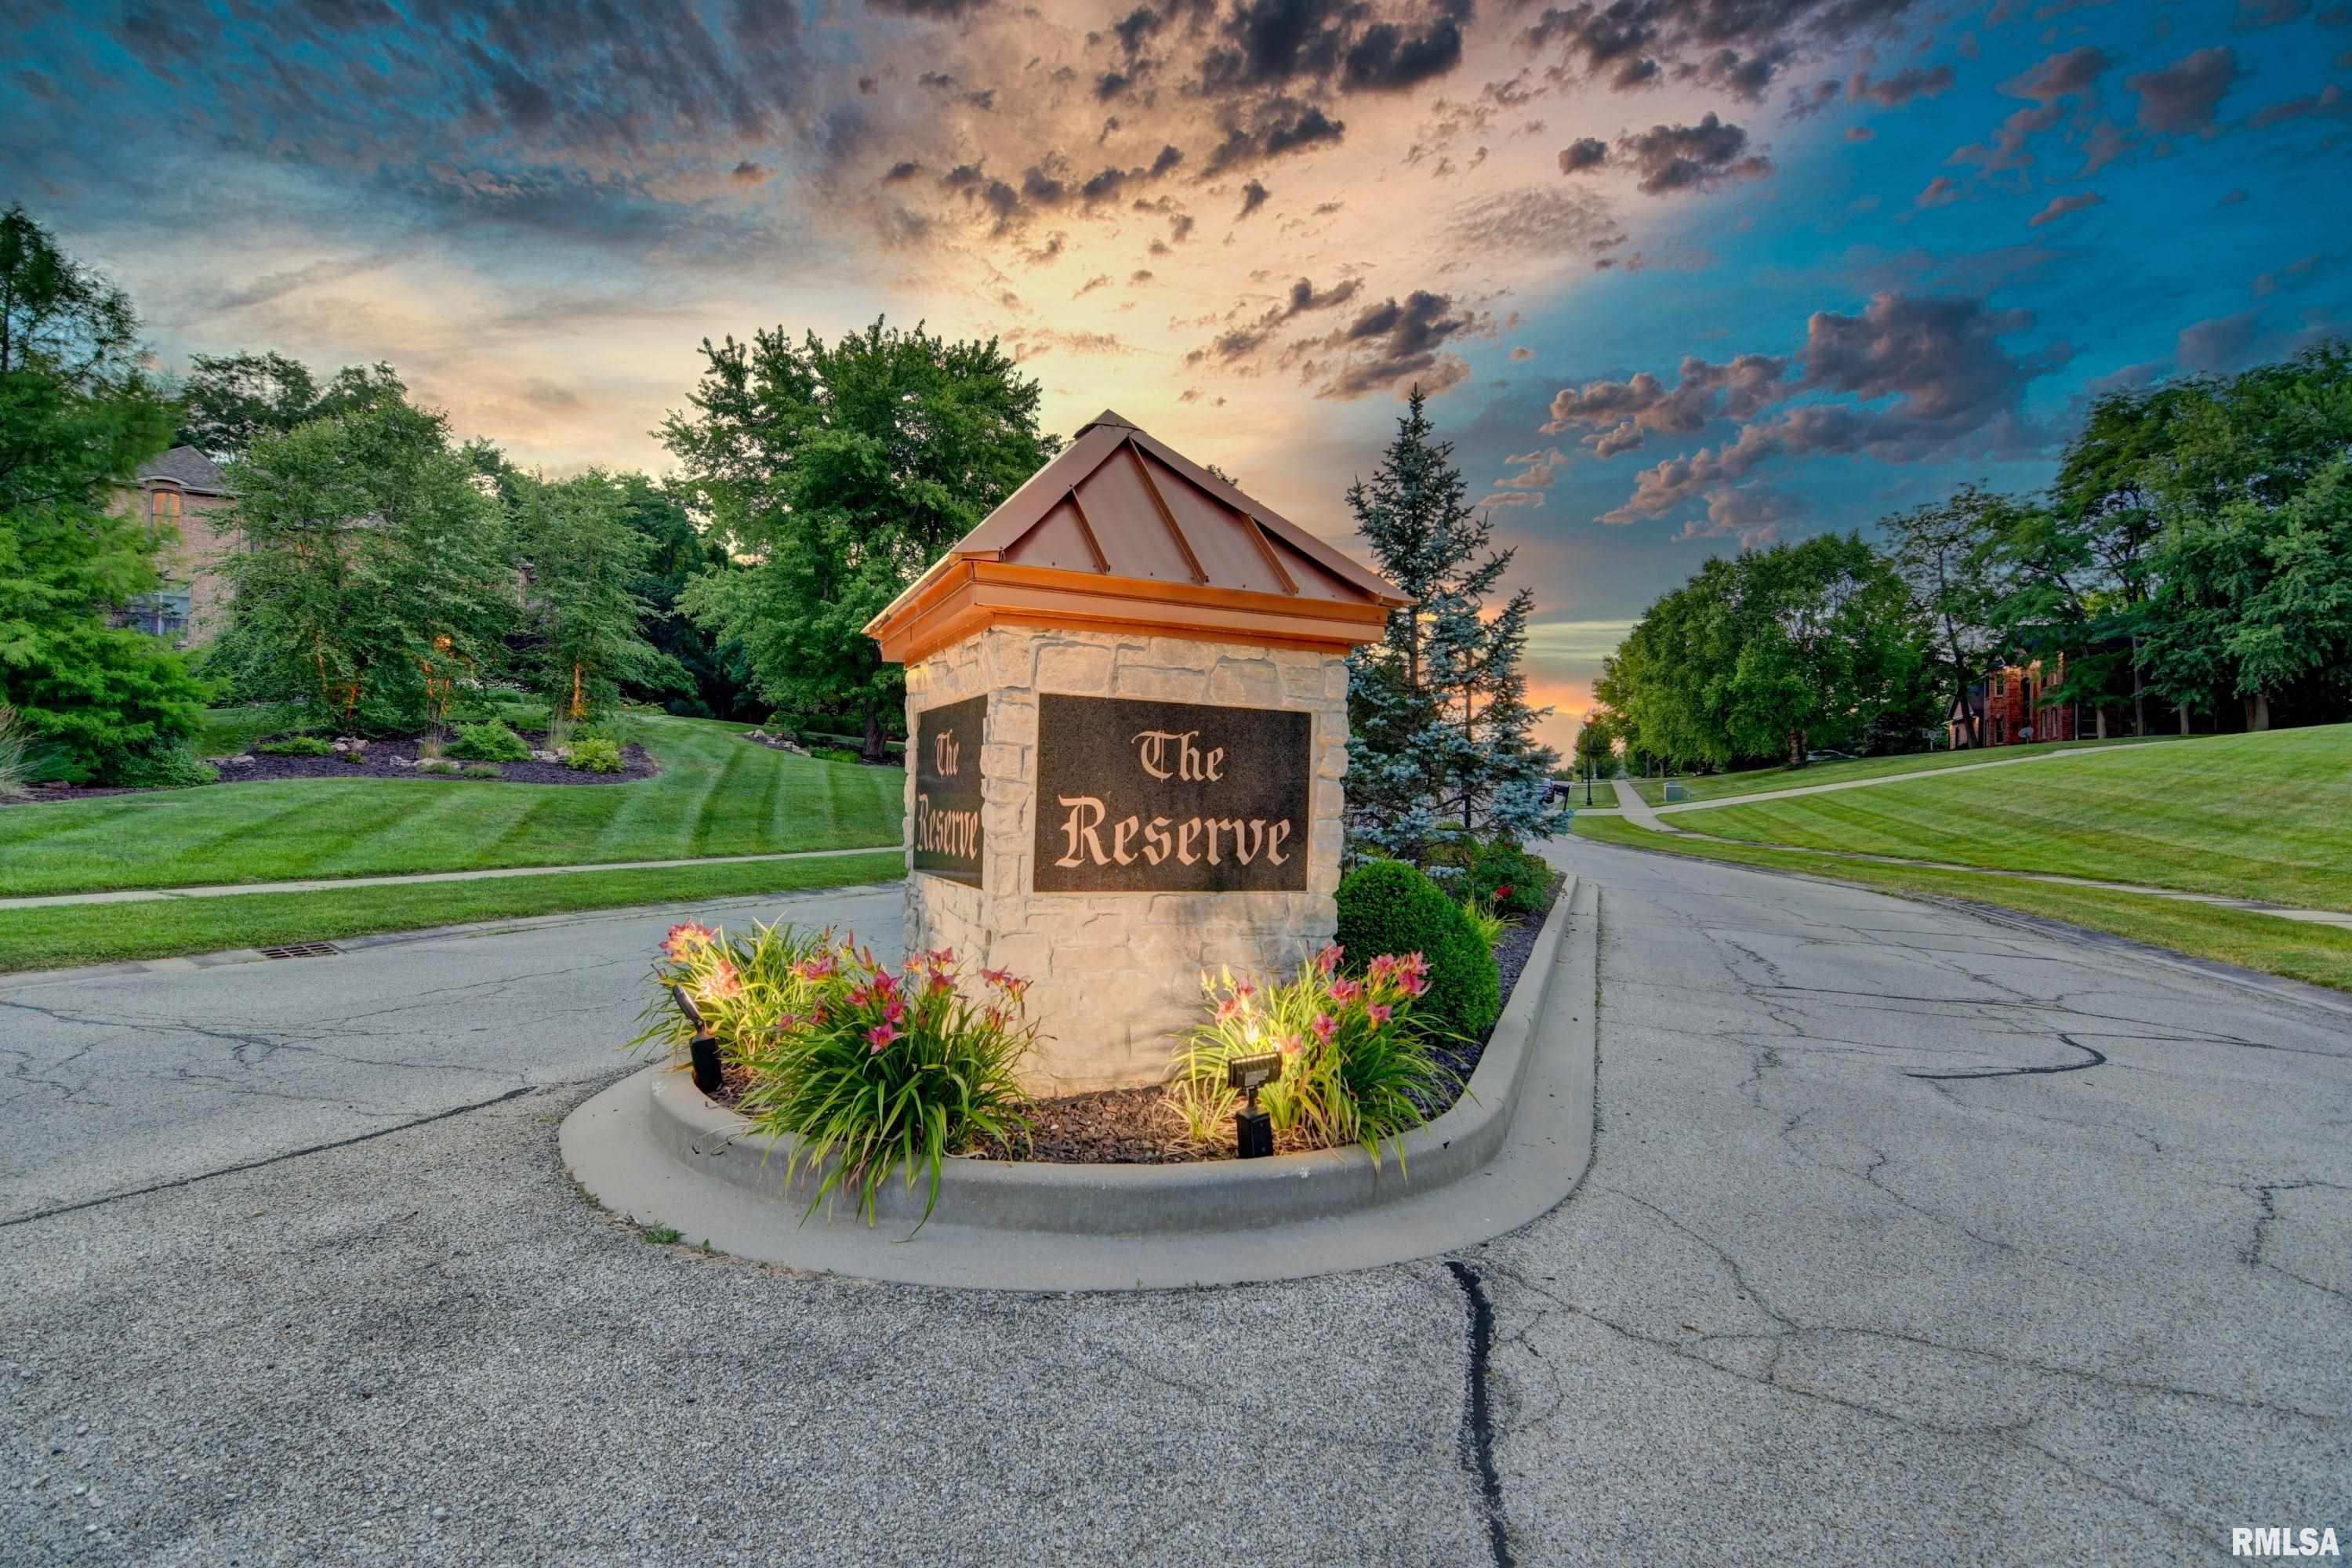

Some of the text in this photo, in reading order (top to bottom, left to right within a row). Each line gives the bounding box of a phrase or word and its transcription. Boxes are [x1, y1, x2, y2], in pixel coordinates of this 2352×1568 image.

[935, 728, 959, 776] The
[1131, 729, 1224, 783] The
[916, 793, 978, 860] Reserve
[1054, 794, 1292, 868] Reserve
